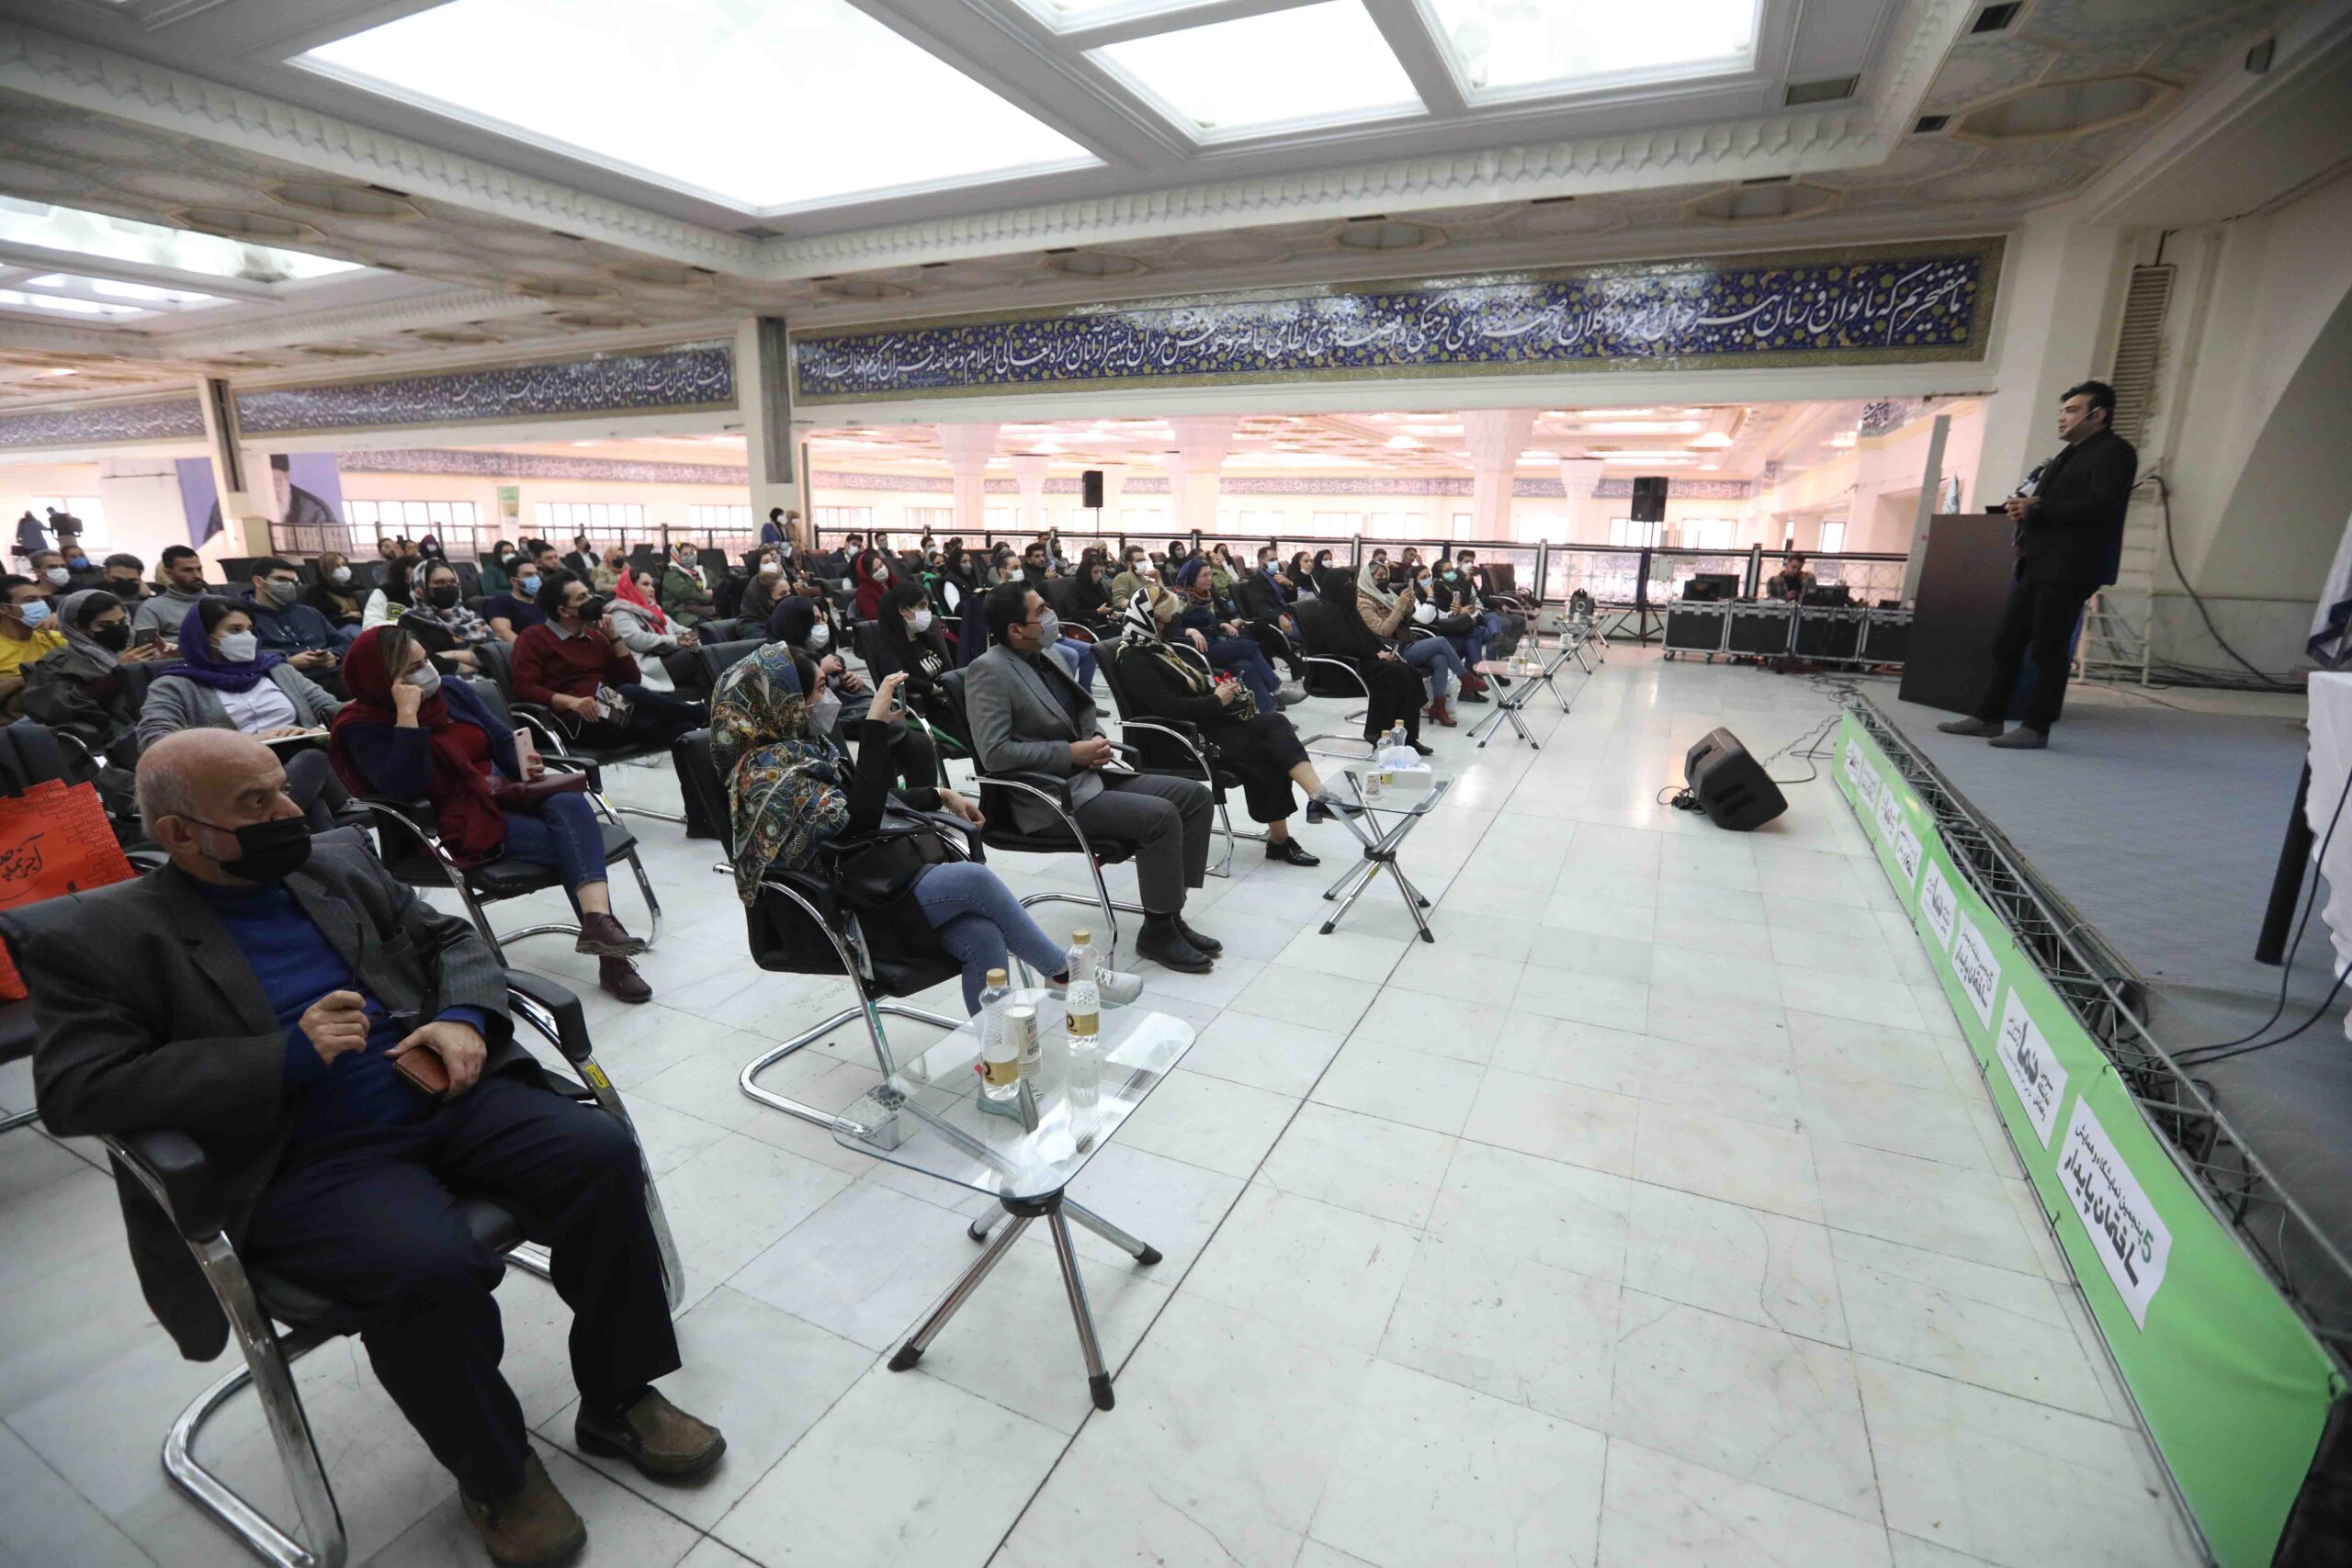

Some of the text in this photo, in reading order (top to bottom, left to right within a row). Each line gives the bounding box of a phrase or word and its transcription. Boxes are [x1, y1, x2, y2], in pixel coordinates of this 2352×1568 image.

[1753, 282, 1816, 337] زنان
[1807, 281, 1876, 333] بانوان
[1876, 263, 1932, 316] که
[1887, 264, 1967, 346] مفتخریم
[1950, 288, 1961, 313] ما
[1687, 294, 1784, 343] پیر
[2141, 1228, 2154, 1264] 5
